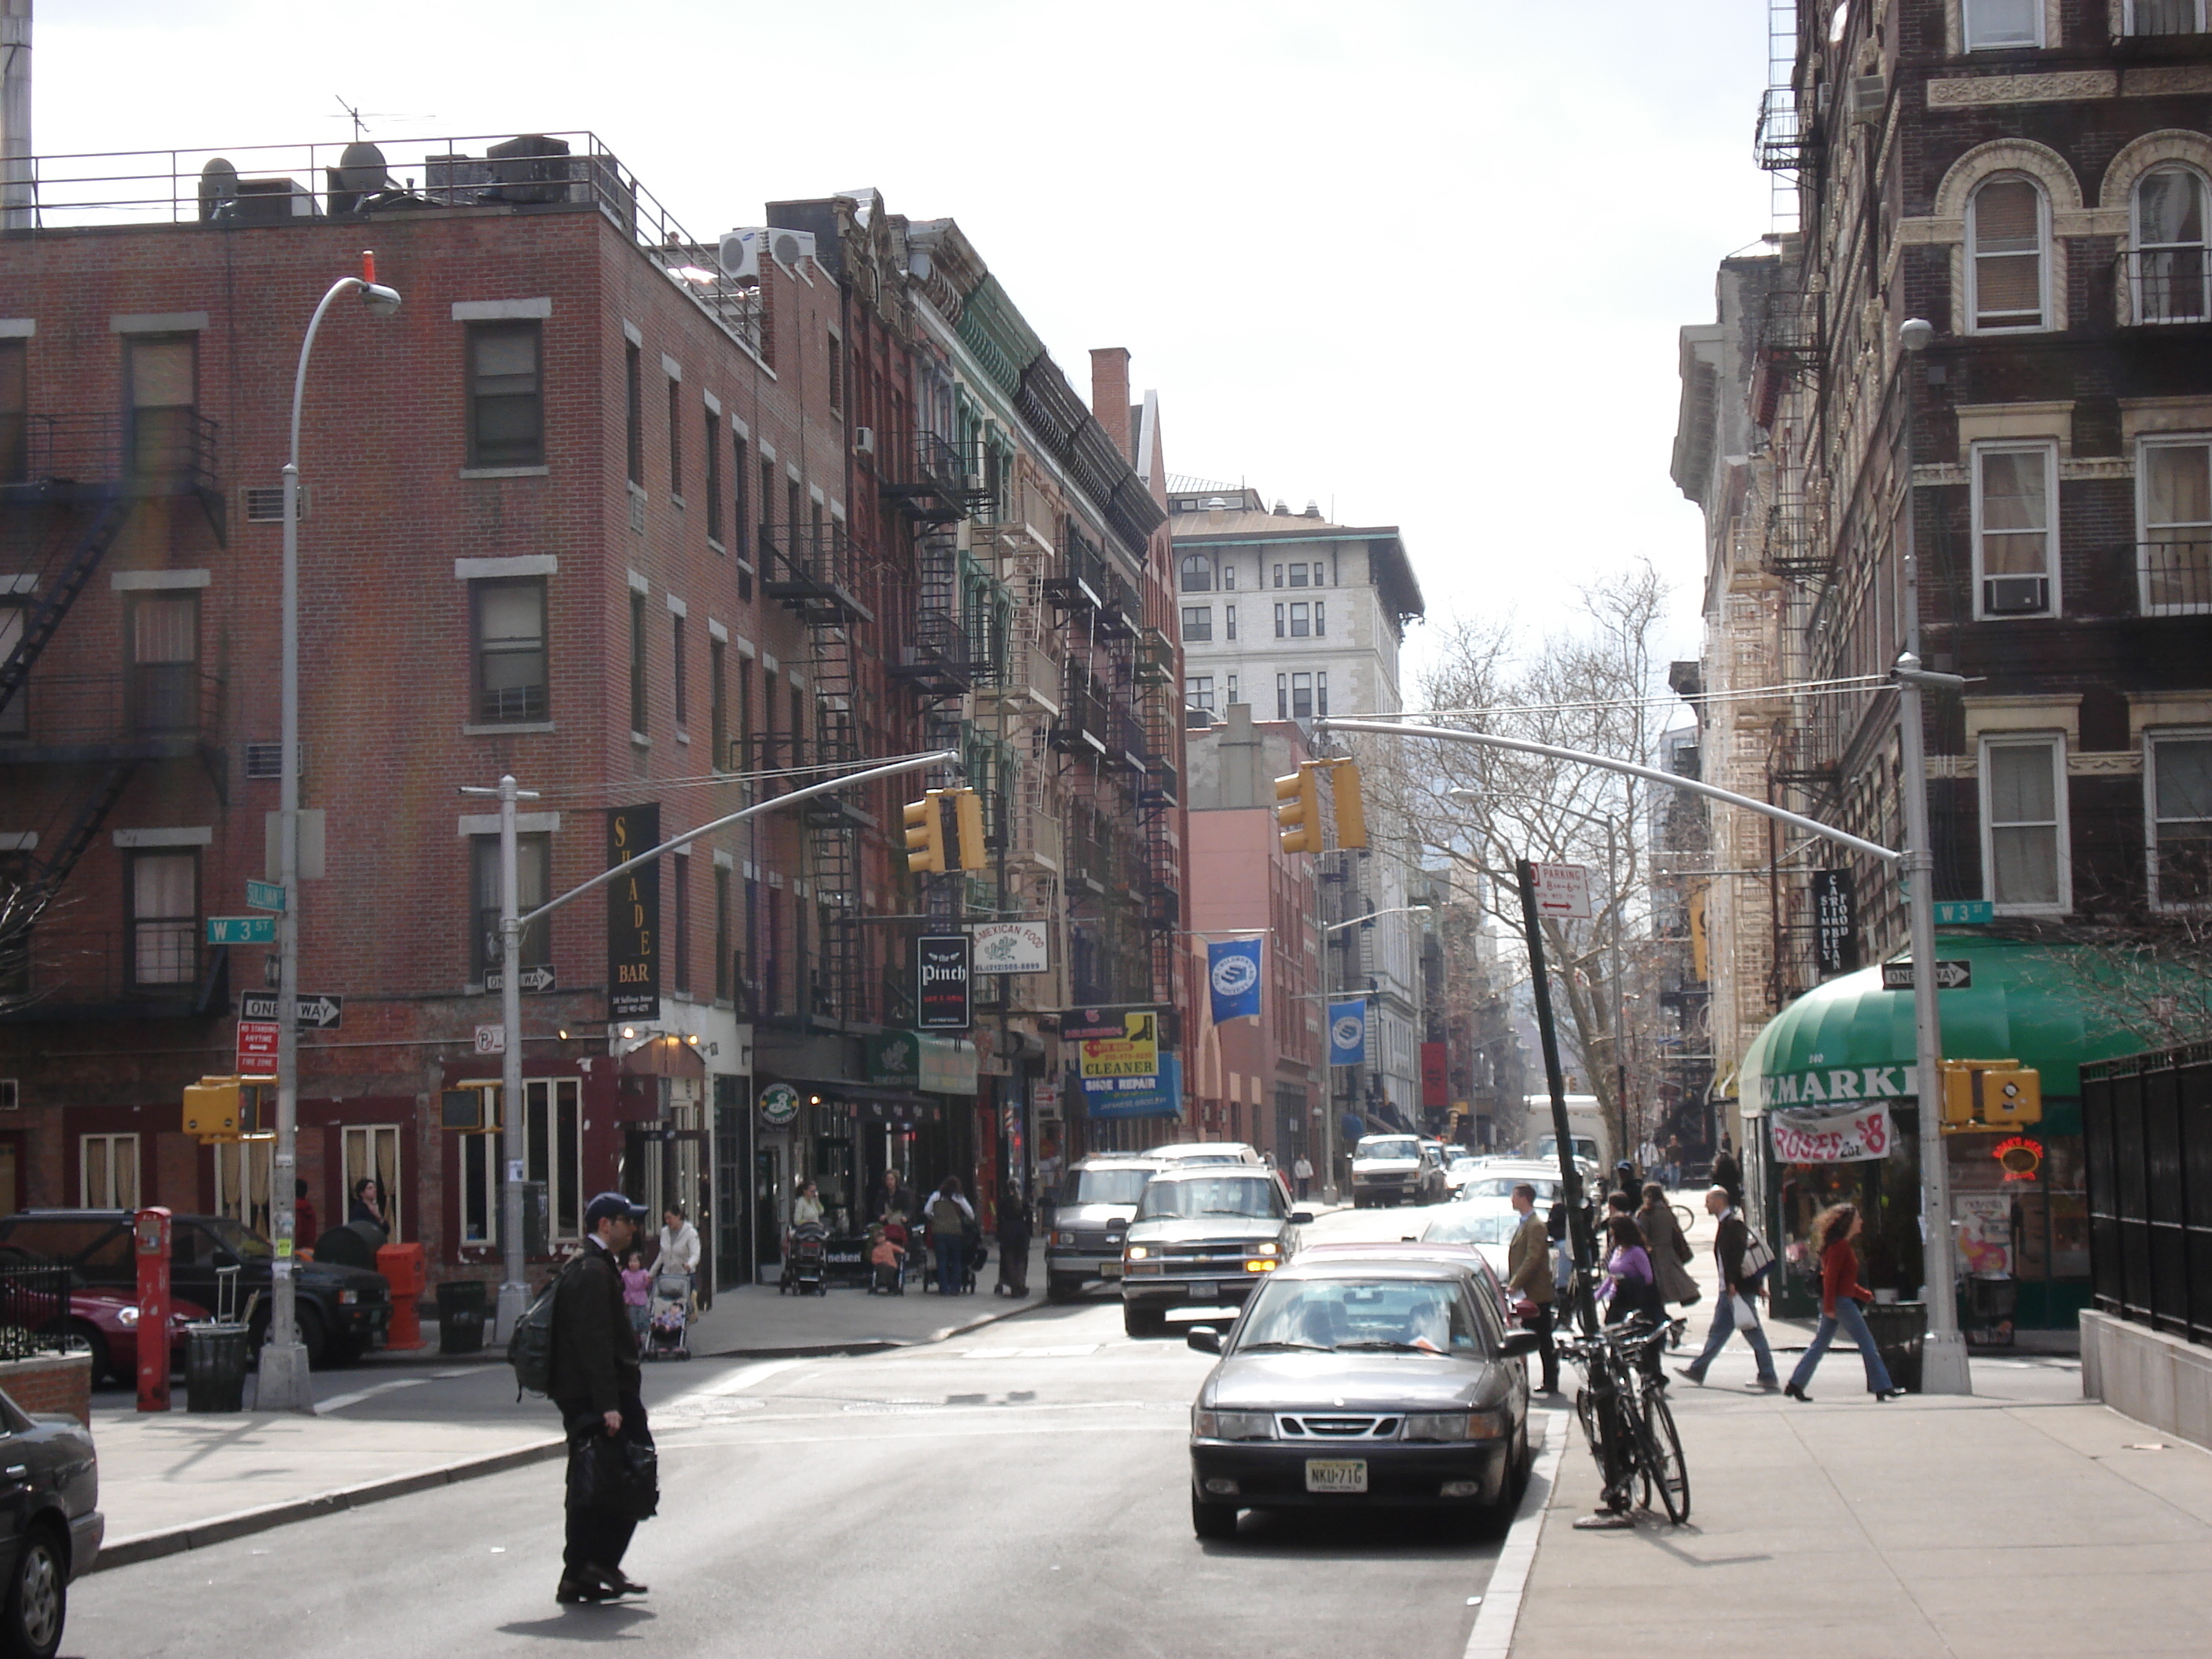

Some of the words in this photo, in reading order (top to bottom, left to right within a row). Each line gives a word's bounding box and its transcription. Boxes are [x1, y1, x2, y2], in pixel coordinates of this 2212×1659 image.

[1543, 869, 1580, 881] PARKING
[1941, 905, 1954, 921] W
[1959, 904, 1968, 921] 3
[1972, 904, 1983, 913] ST
[1820, 895, 1830, 961] SIMPLY
[1829, 873, 1840, 970] CARIBBEAN
[1839, 892, 1849, 936] FOOD
[213, 921, 228, 941] W
[240, 921, 251, 940] 3
[255, 921, 269, 931] ST
[1023, 929, 1045, 949] FOOD
[525, 973, 545, 984] WAY
[618, 964, 650, 983] BAR
[921, 964, 966, 987] Pinch
[1890, 972, 1914, 983] ONE
[301, 1004, 329, 1018] WAY
[245, 1034, 272, 1043] ANYTIME
[1086, 1061, 1153, 1075] CLEANER
[1085, 1079, 1114, 1091] SHOE
[1119, 1077, 1156, 1090] REPAIR
[1774, 1127, 1843, 1160] ROSES
